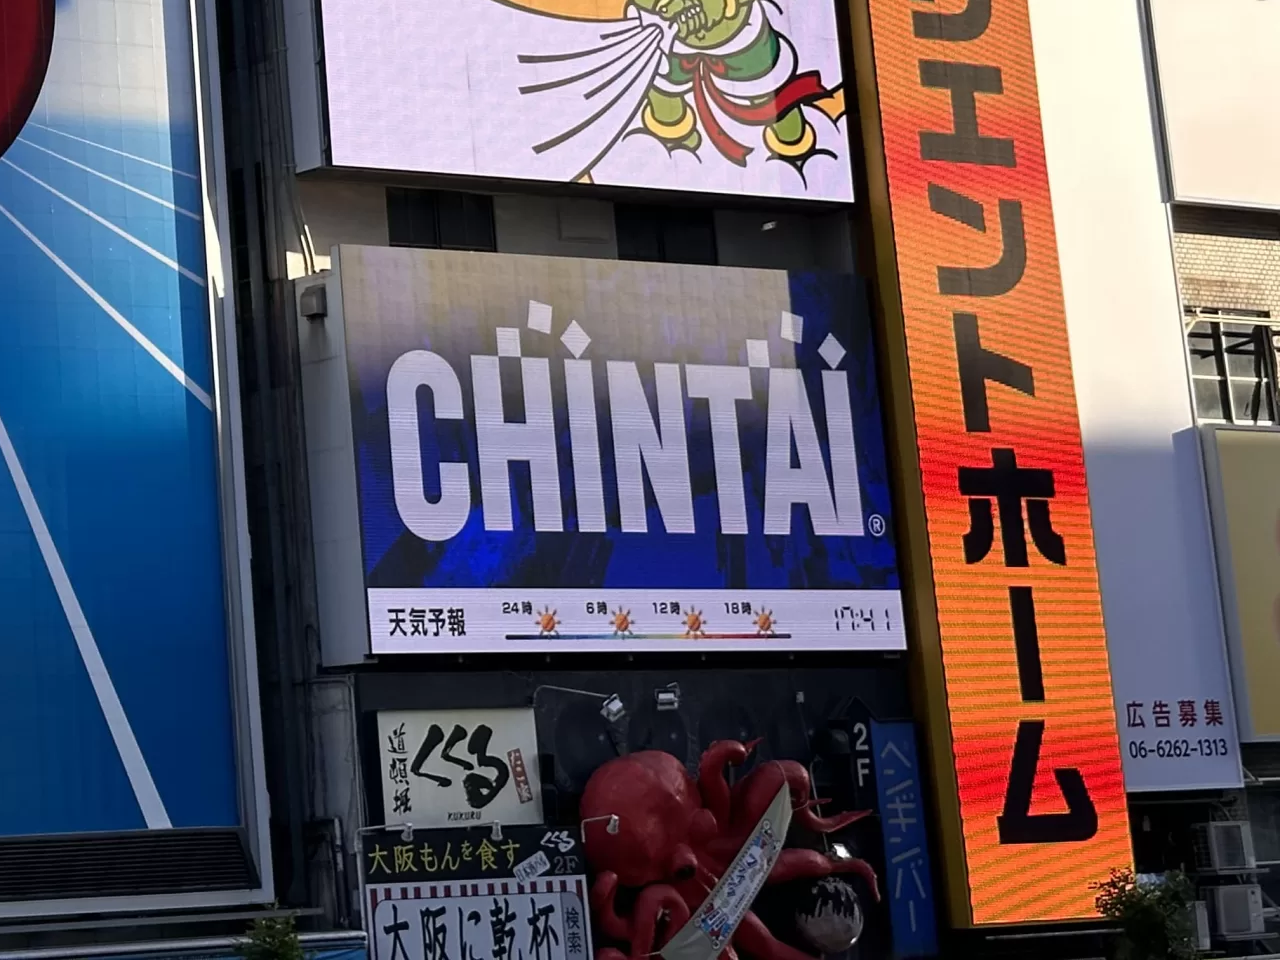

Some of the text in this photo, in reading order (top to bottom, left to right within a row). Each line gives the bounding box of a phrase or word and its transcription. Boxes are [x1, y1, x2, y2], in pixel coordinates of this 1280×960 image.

[387, 607, 467, 637] 天気予報
[502, 601, 752, 616] 24時 6時 12時 18時
[833, 605, 891, 632] 17:41
[1126, 698, 1224, 728] 広告募集
[853, 722, 870, 787] 2F
[1128, 737, 1228, 760] 06-6262-1313
[387, 722, 412, 816] 道頓堀
[410, 724, 510, 809] くくる
[447, 810, 482, 821] KUKURU
[368, 838, 521, 875] 大阪もんを食す
[554, 855, 580, 874] 2F
[383, 896, 560, 960] 大阪に乾杯
